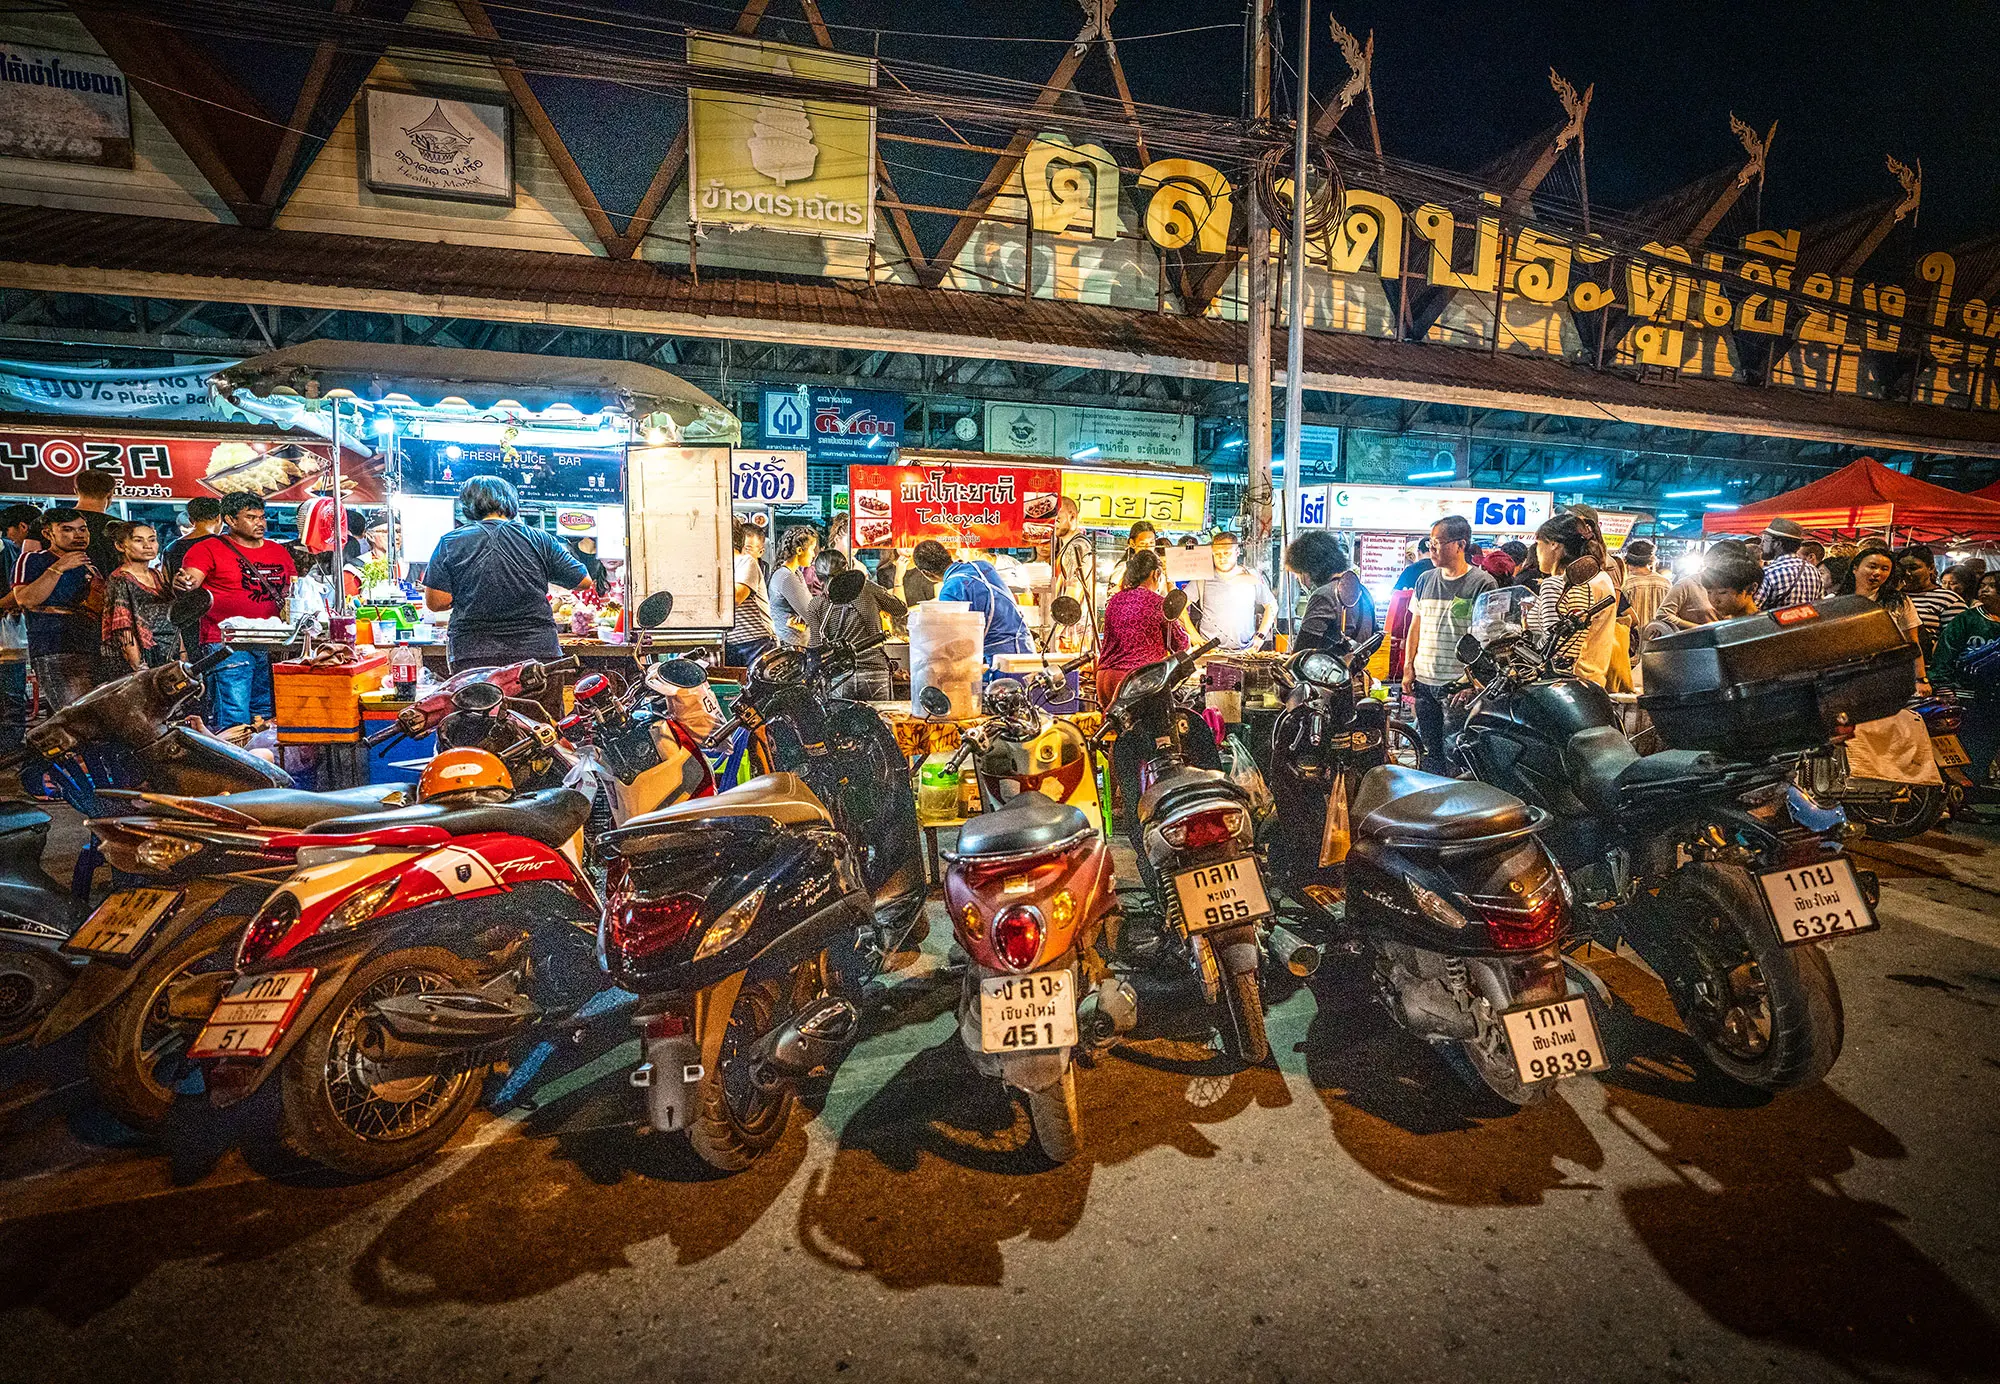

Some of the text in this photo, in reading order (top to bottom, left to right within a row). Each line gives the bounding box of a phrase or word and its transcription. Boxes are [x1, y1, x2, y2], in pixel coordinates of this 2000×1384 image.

[396, 165, 482, 189] Healthy Market
[701, 177, 864, 226] ข้าวตราฉัตร
[159, 375, 188, 389] No
[117, 390, 211, 407] Plastic Ba
[462, 450, 501, 462] FRESH
[558, 456, 582, 467] BAR
[915, 507, 1001, 528] Takoyaki
[1300, 493, 1325, 524] โรตี
[1474, 497, 1527, 526] โรตี
[494, 856, 555, 879] Fino
[1193, 863, 1239, 889] กลท
[1784, 865, 1834, 891] 1กย
[1207, 888, 1237, 902] พะเยา
[1794, 891, 1840, 911] เชียงใหม่
[1205, 900, 1249, 925] 965
[1793, 909, 1857, 937] 6321
[87, 930, 129, 950] 177
[1001, 1001, 1056, 1021] เชียงใหม่
[1524, 1003, 1572, 1030] 1กพ
[218, 1029, 249, 1049] 51
[1002, 1022, 1054, 1047] 451
[1532, 1029, 1576, 1051] เชียงใหม่
[1529, 1050, 1592, 1079] 9839
